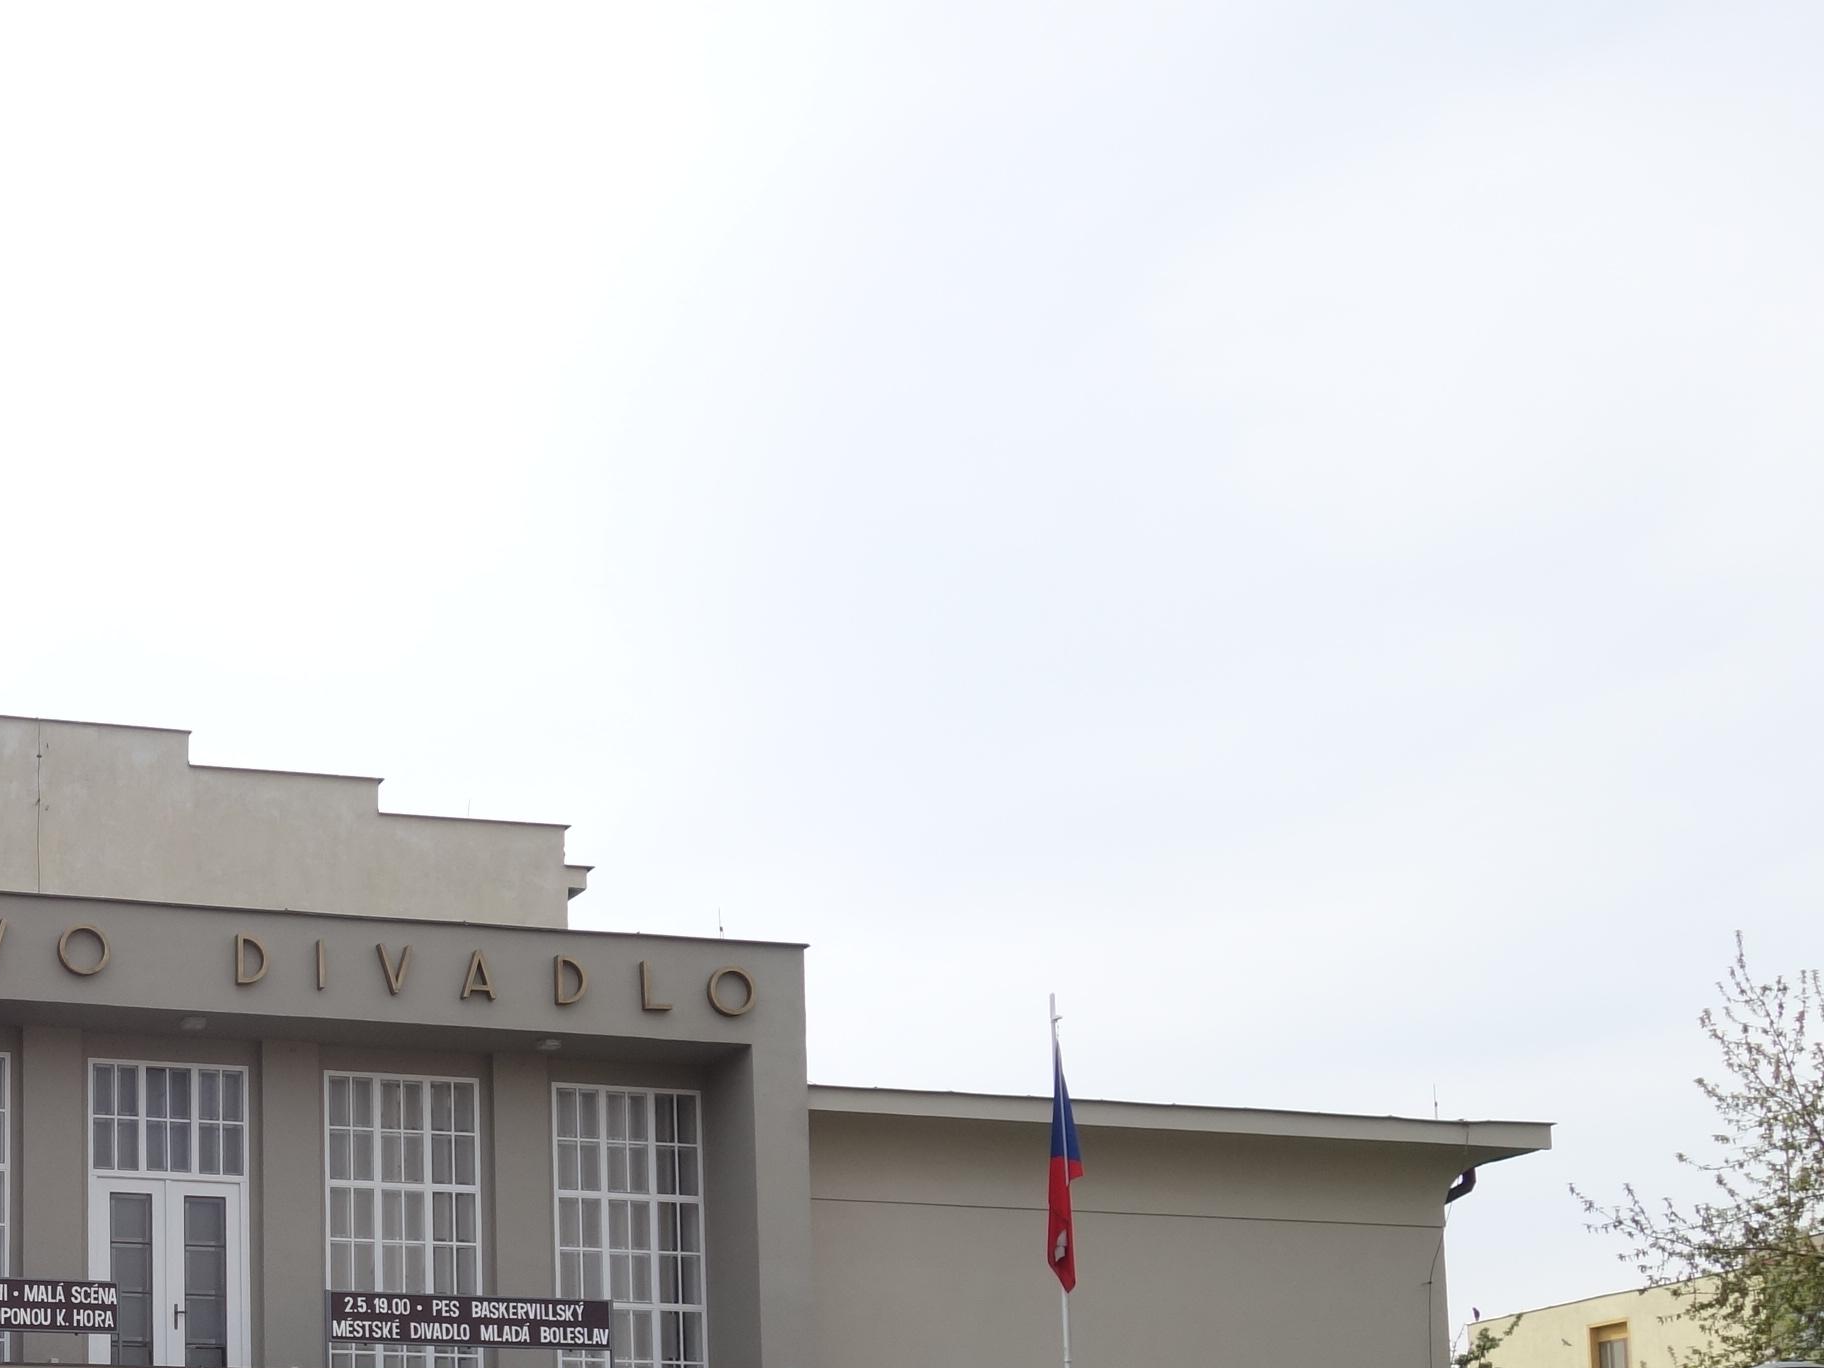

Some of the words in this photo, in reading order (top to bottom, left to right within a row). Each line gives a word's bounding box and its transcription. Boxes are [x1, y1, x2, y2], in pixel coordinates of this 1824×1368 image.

[235, 934, 756, 1017] DIVADLO
[24, 1283, 65, 1302] MALÁ
[71, 1284, 117, 1305] SCÉNA
[56, 1309, 69, 1326] K.
[73, 1309, 114, 1328] HORA
[432, 1300, 460, 1317] PES
[471, 1301, 584, 1321] BASKERVILLSKÝ
[410, 1322, 470, 1340] DIVADLO
[480, 1323, 530, 1343] MLADÁ
[540, 1326, 609, 1345] BOLESLAV
